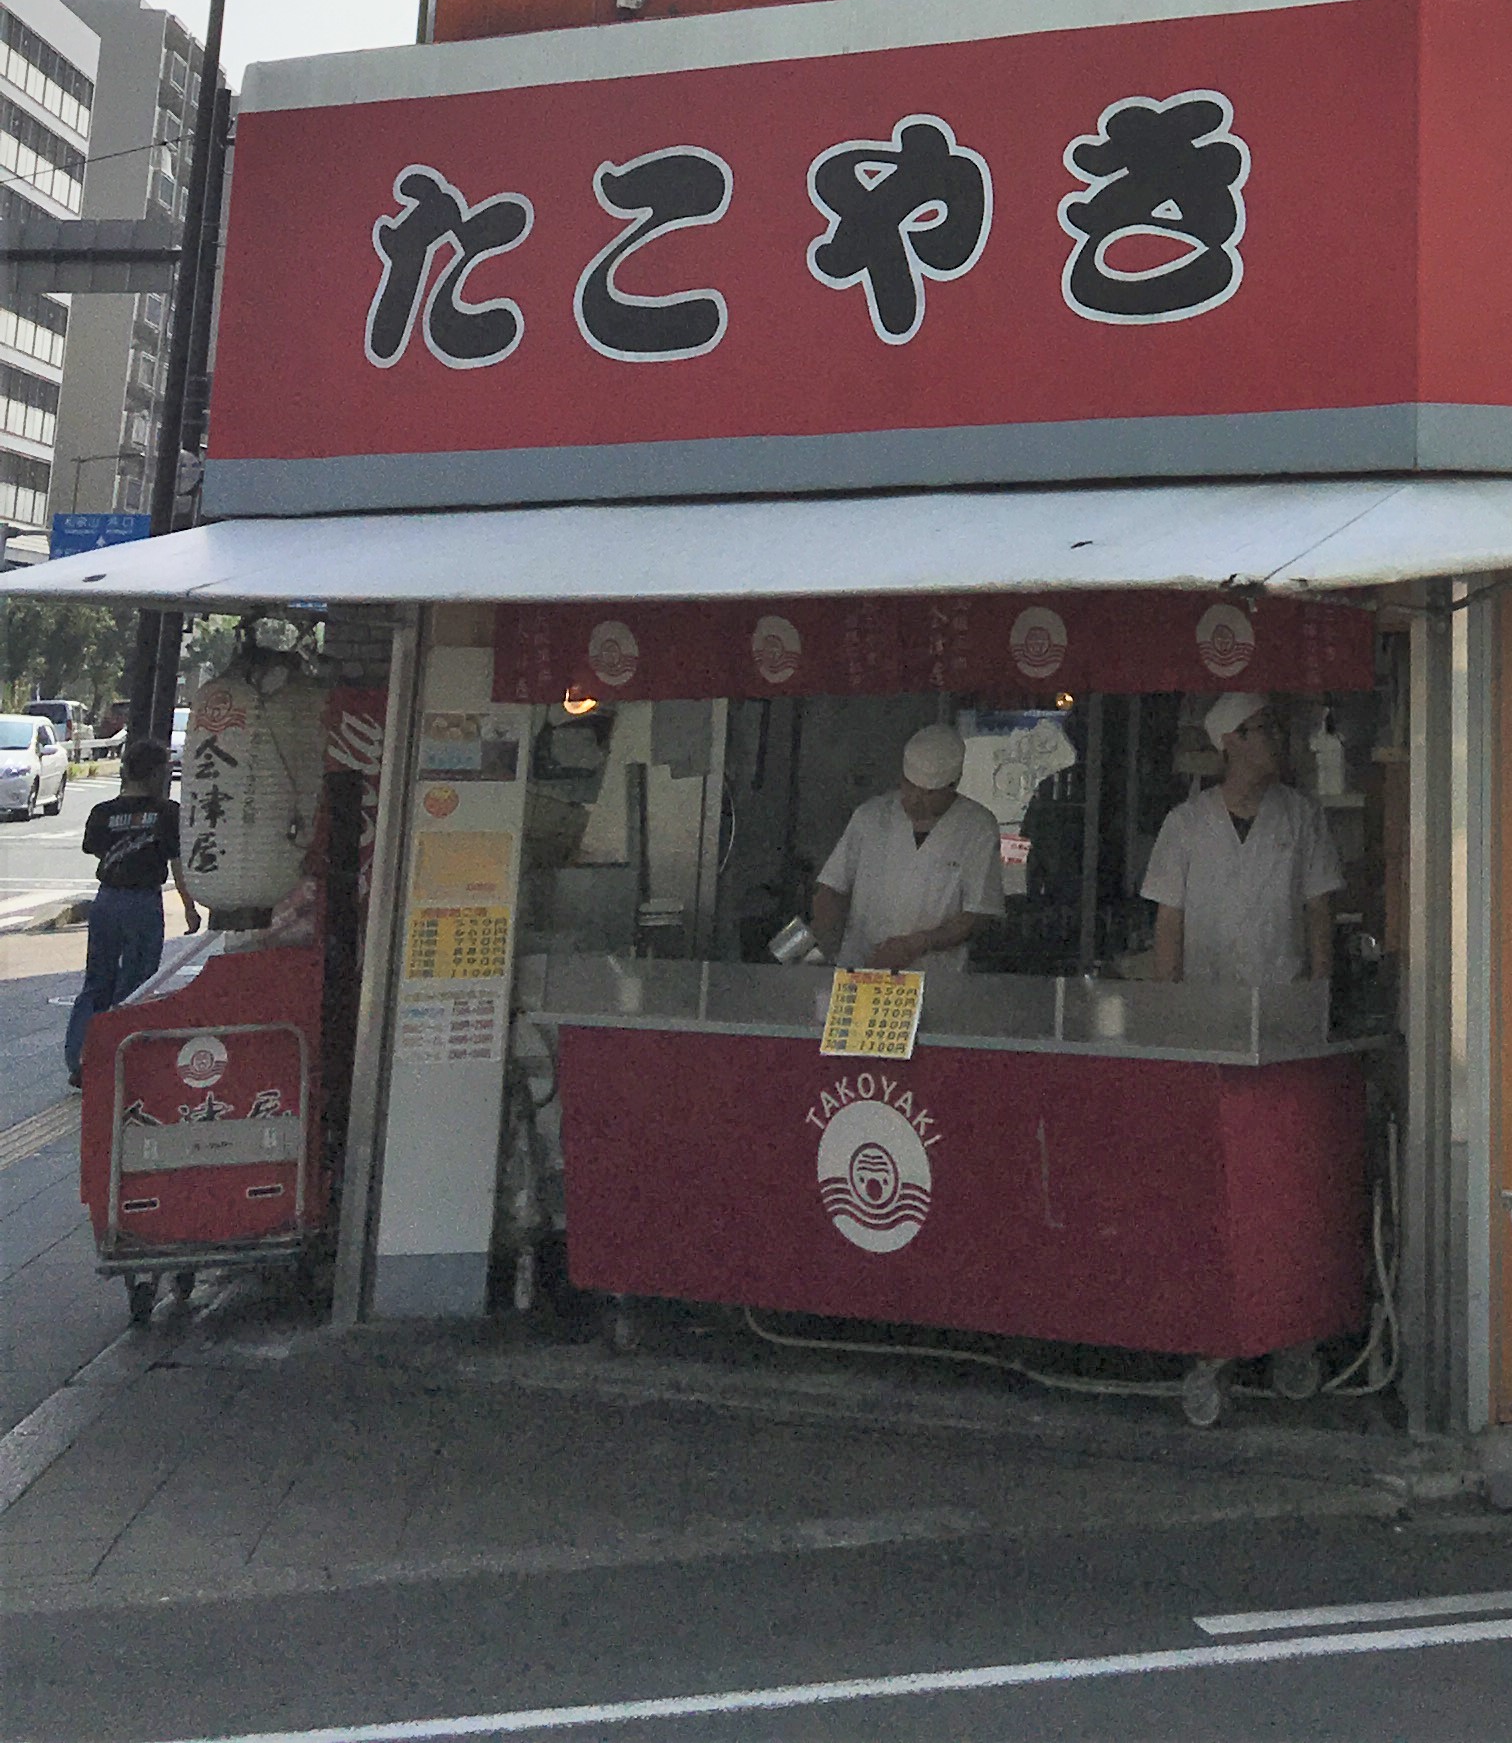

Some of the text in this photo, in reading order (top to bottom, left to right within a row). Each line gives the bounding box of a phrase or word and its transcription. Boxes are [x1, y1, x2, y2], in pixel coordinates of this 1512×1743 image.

[365, 89, 1251, 370] たこやき
[187, 734, 239, 874] 会津屋
[805, 1072, 943, 1148] TAKOYAKI
